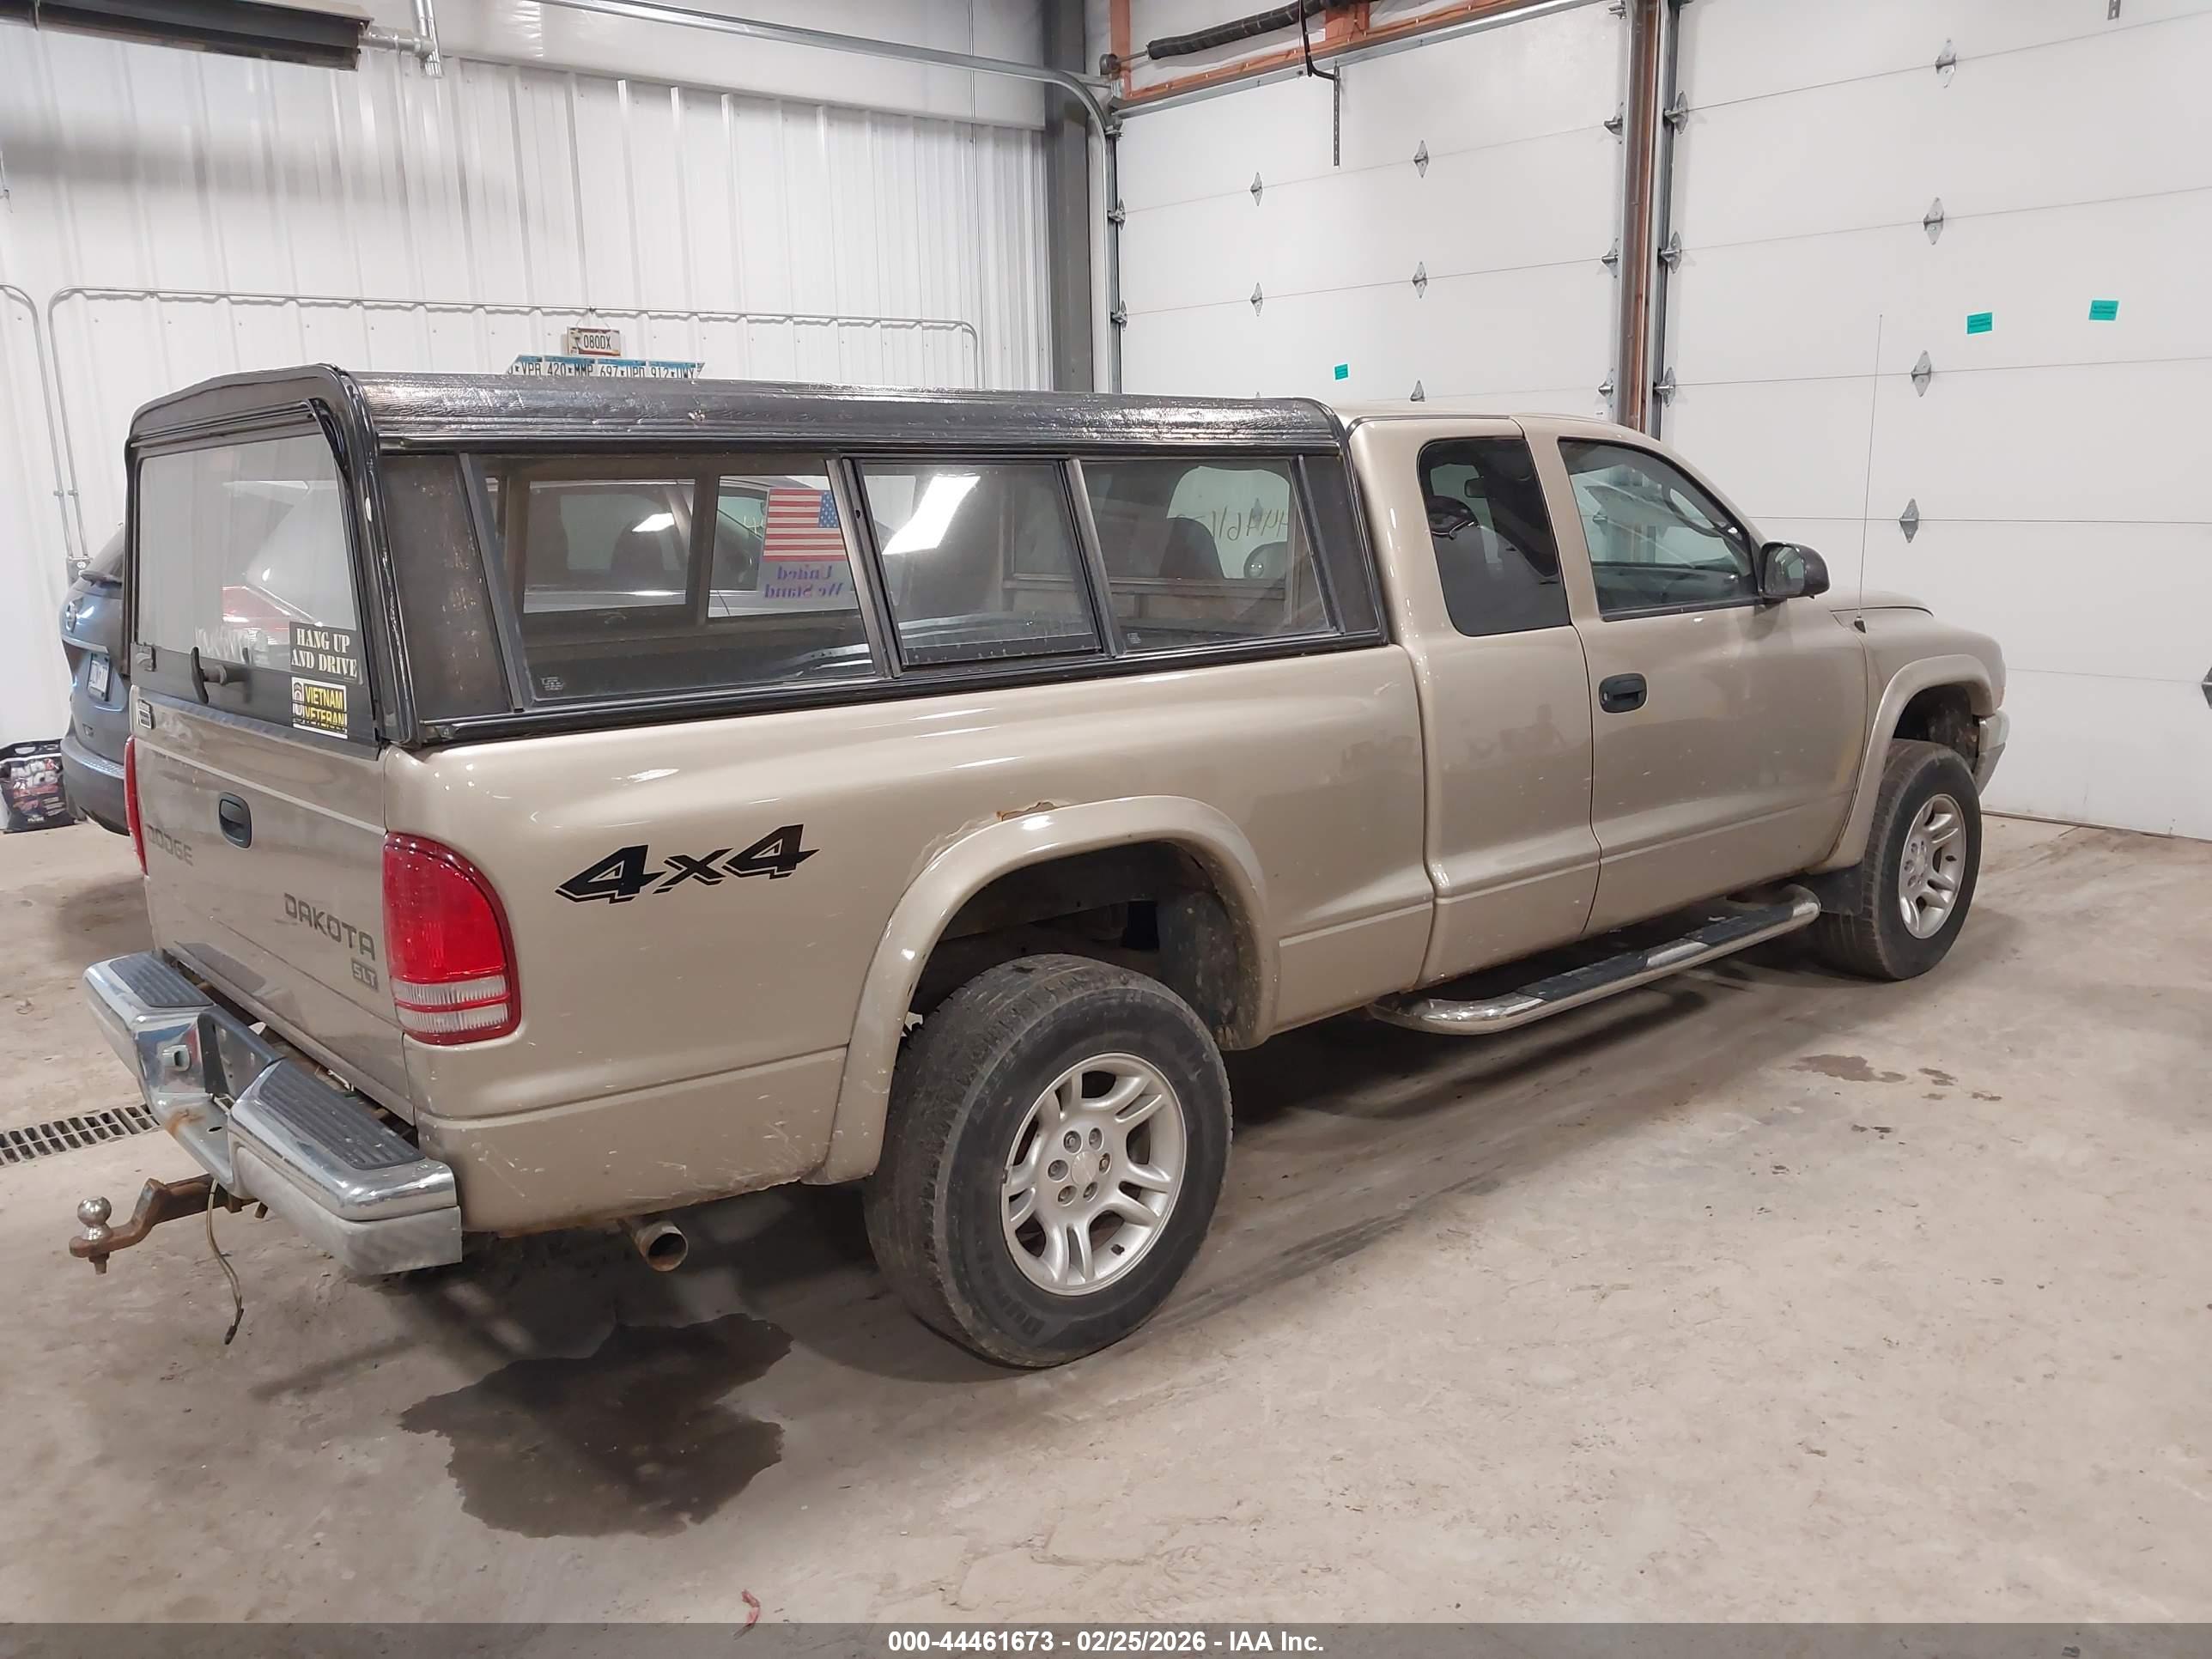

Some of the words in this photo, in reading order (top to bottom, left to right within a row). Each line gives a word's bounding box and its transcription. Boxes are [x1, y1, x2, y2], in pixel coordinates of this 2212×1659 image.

[296, 628, 330, 650] HANG
[333, 633, 350, 653] UP
[291, 647, 315, 669] AND
[319, 653, 357, 678] DRIVE
[305, 685, 343, 709] VIETNAM
[305, 706, 344, 726] VETERAN
[145, 823, 194, 866] DODGE
[555, 823, 820, 903] 4x4
[284, 892, 375, 961] DAKOTA
[351, 959, 378, 991] SLT
